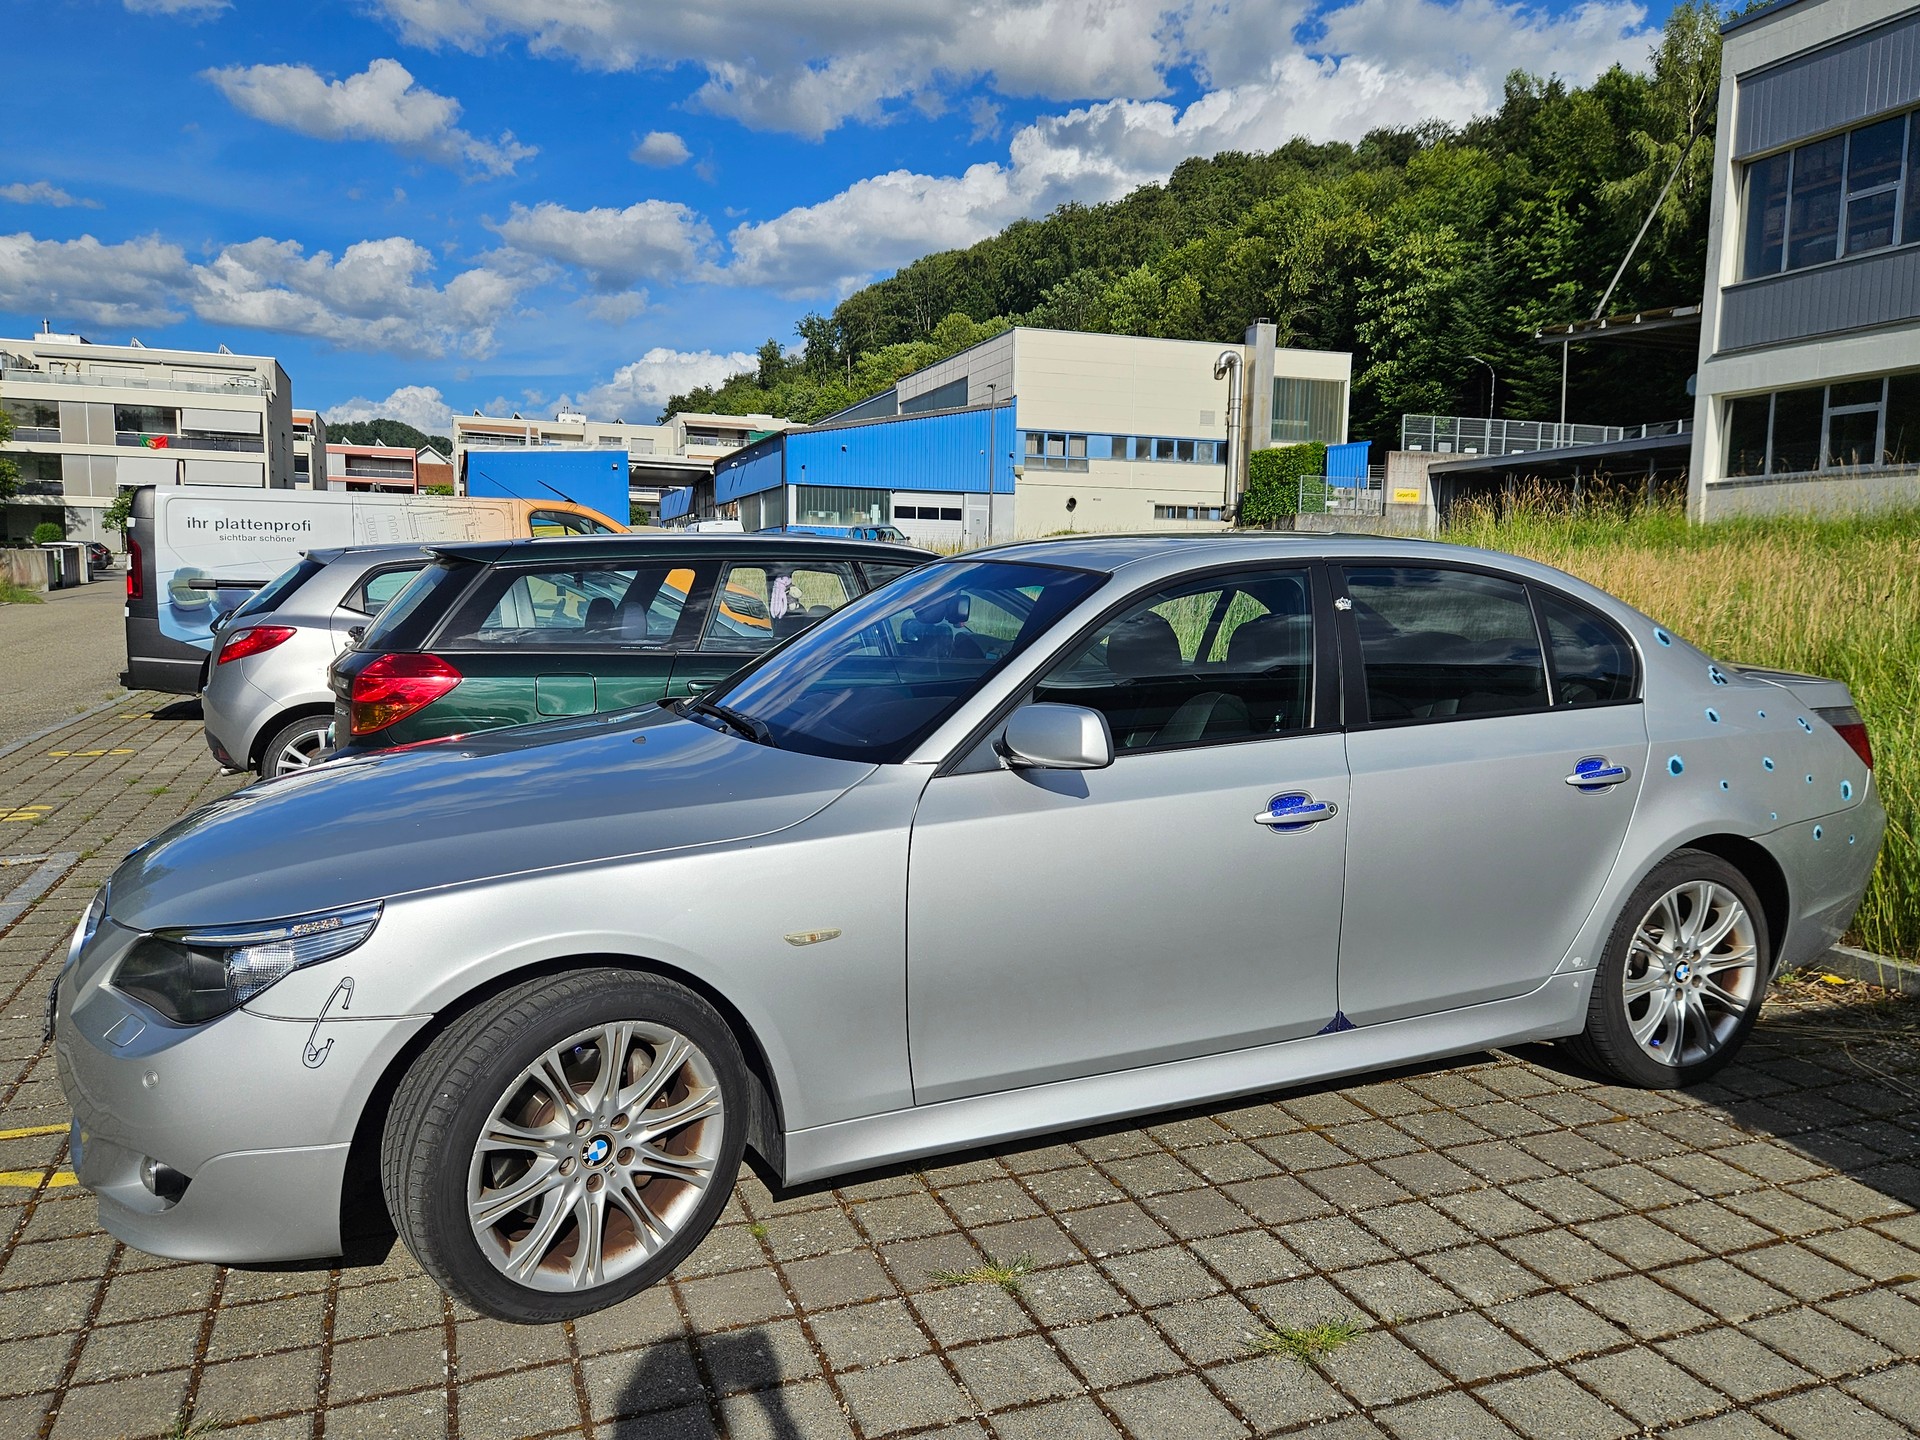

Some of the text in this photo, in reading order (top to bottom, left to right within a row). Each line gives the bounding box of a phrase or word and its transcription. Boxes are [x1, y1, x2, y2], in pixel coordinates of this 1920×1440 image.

[186, 516, 312, 533] ihr plattenprofi
[219, 533, 296, 543] sichtbar schöner
